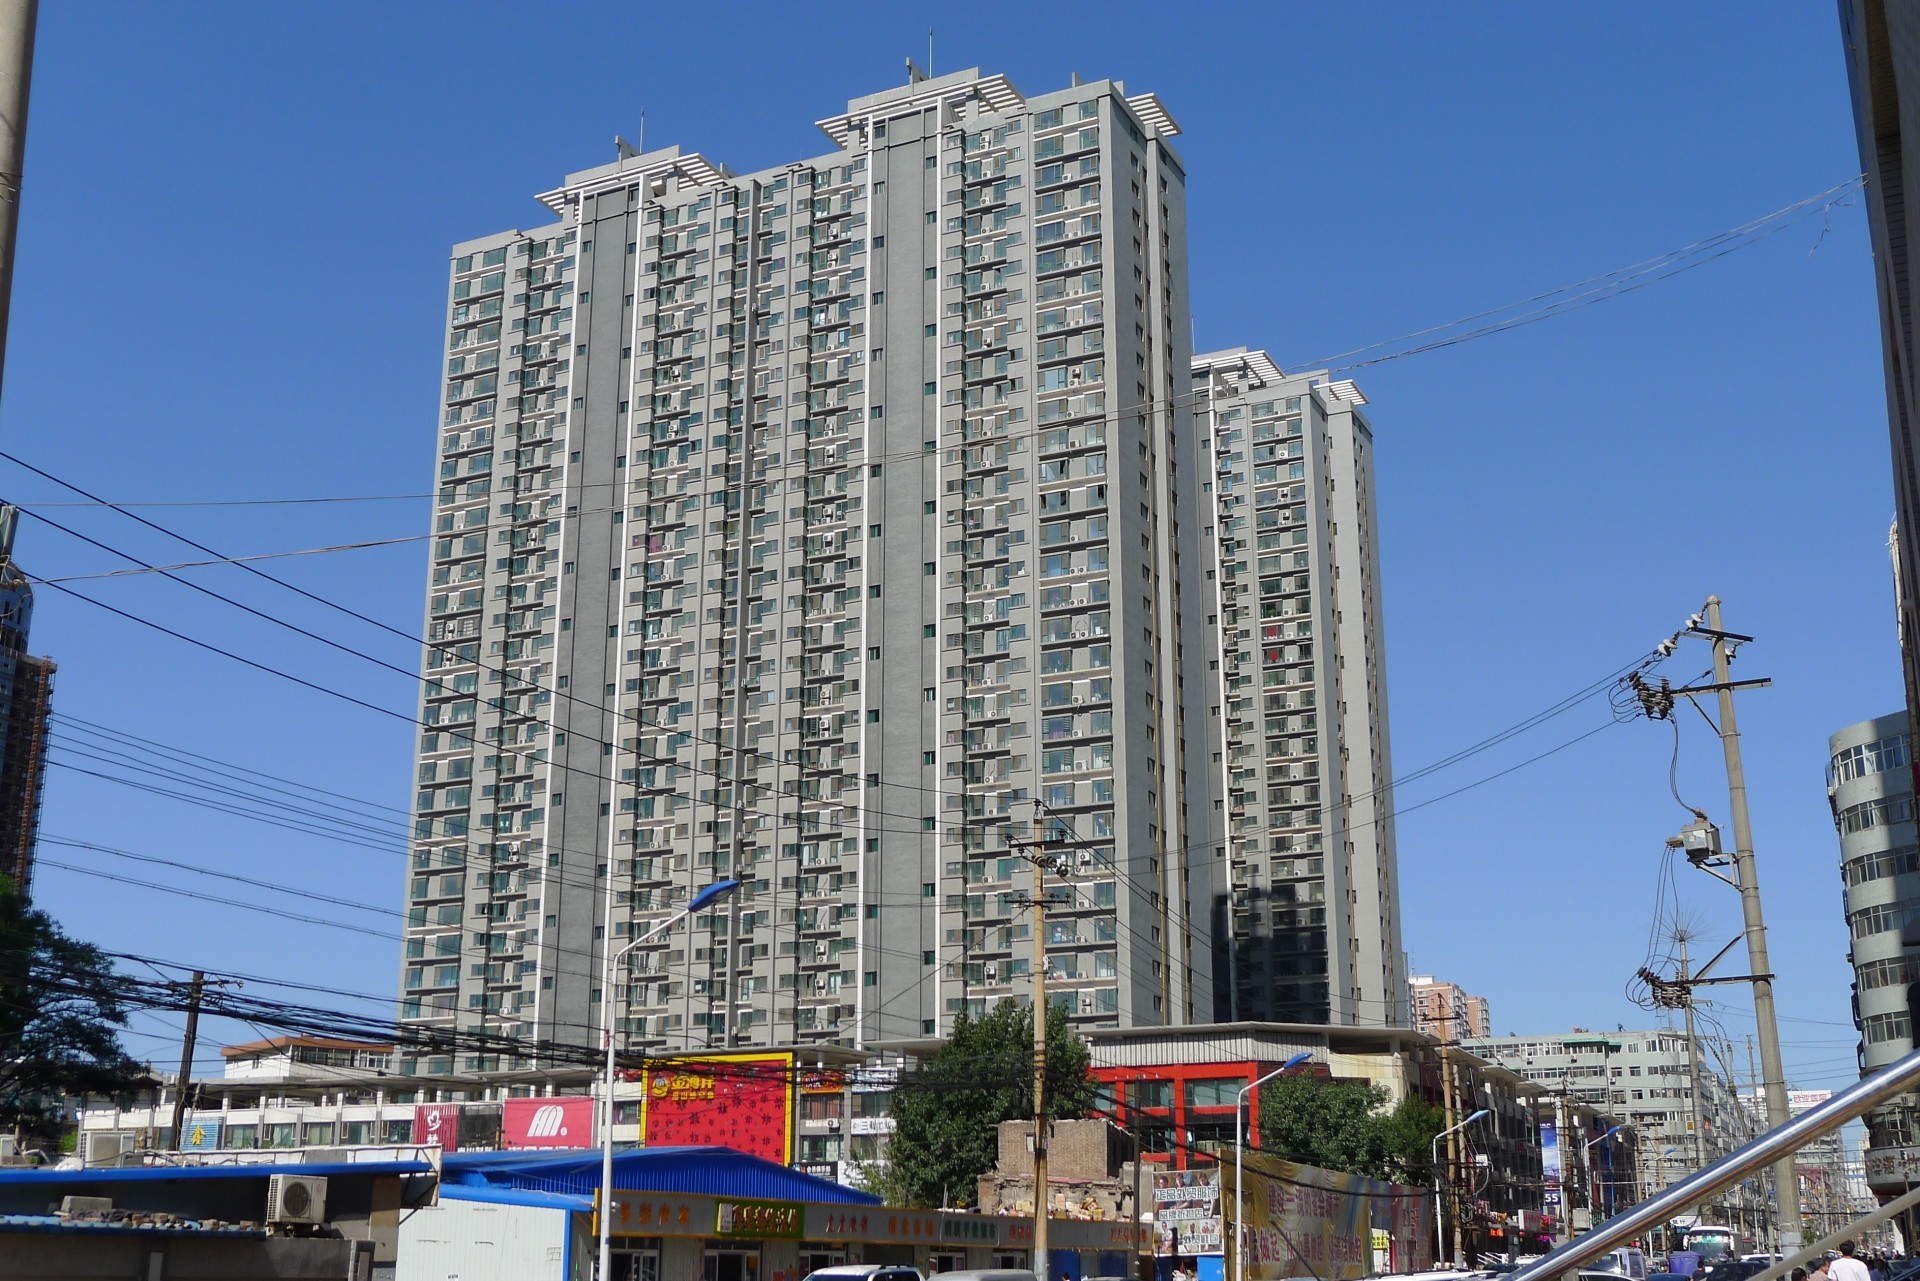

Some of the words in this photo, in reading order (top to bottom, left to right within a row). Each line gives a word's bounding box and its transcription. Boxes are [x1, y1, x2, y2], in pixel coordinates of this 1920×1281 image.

[1156, 1186, 1219, 1201] 正品外贸服饰
[1545, 1193, 1558, 1202] 55
